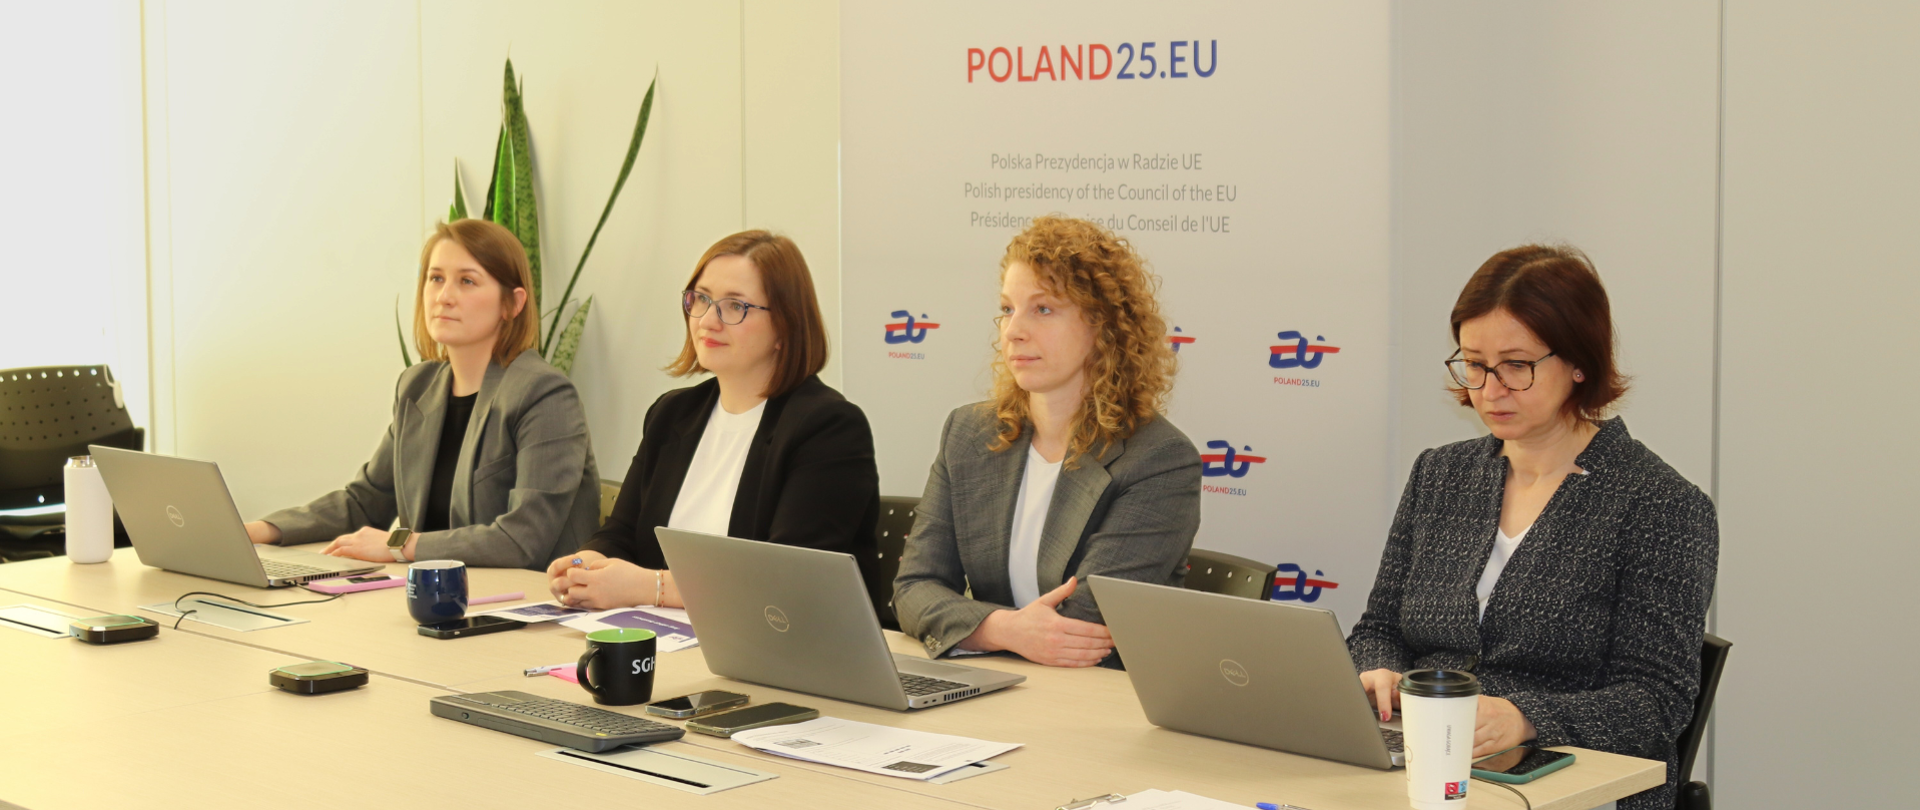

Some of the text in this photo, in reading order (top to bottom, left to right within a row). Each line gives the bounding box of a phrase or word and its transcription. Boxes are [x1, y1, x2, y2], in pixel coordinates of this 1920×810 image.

[967, 39, 1217, 83] POLAND25.EU
[991, 153, 1202, 173] Polska Prezydencja w Radzie UE
[964, 182, 1236, 202] Polish presidency of the Council of the EU
[971, 211, 1034, 228] Présidenc
[1107, 213, 1124, 230] du
[1127, 214, 1177, 231] Conseil
[1181, 215, 1198, 232] de
[1202, 215, 1230, 233] l'UE
[888, 351, 925, 360] POLAND25.EU
[1273, 376, 1320, 388] POLAND25.EU
[1203, 484, 1247, 496] POLAND25.EU
